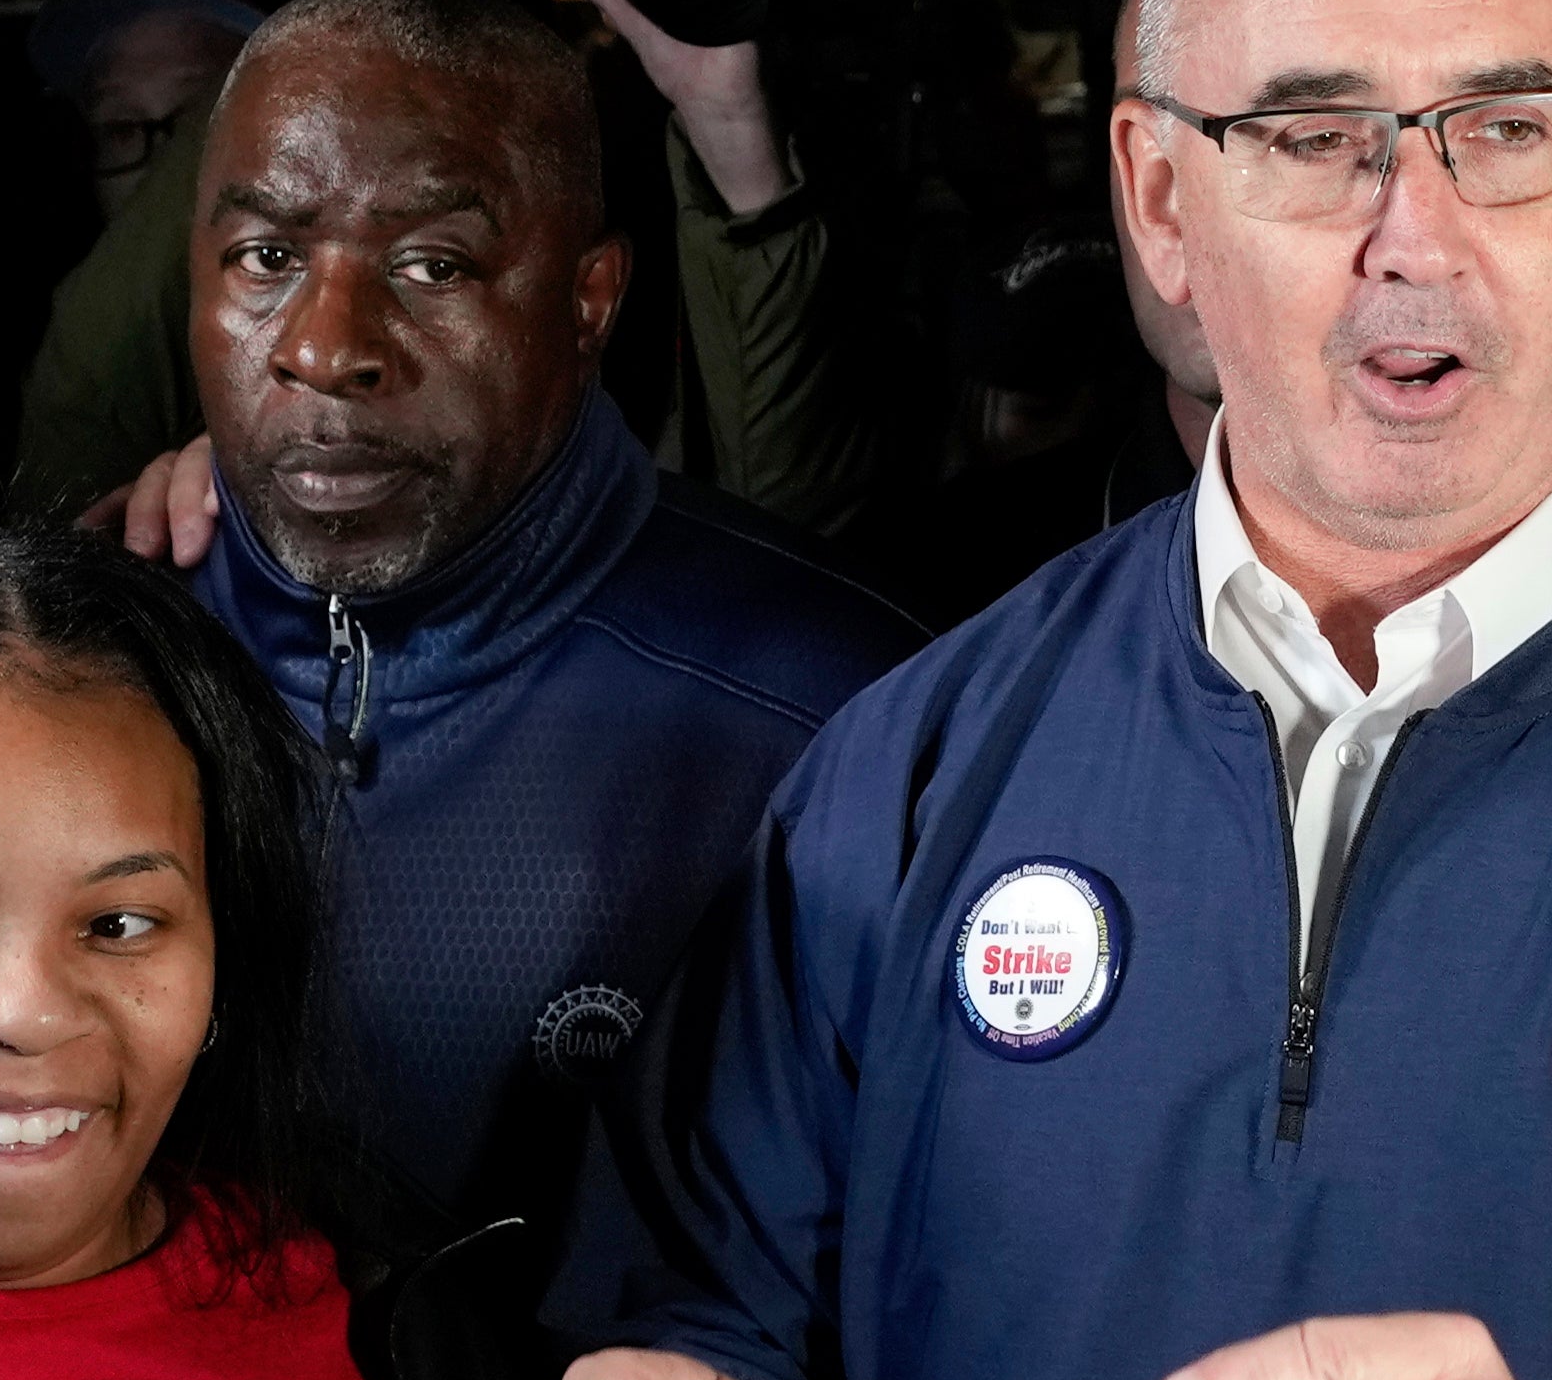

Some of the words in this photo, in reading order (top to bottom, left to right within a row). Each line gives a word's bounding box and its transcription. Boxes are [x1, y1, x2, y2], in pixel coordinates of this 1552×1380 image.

[955, 923, 972, 953] COLA
[981, 919, 1019, 935] Don't
[982, 945, 1072, 975] Strike
[989, 979, 1015, 995] But
[1018, 979, 1025, 995] I
[1030, 979, 1065, 995] Will!
[566, 1029, 621, 1060] UAW
